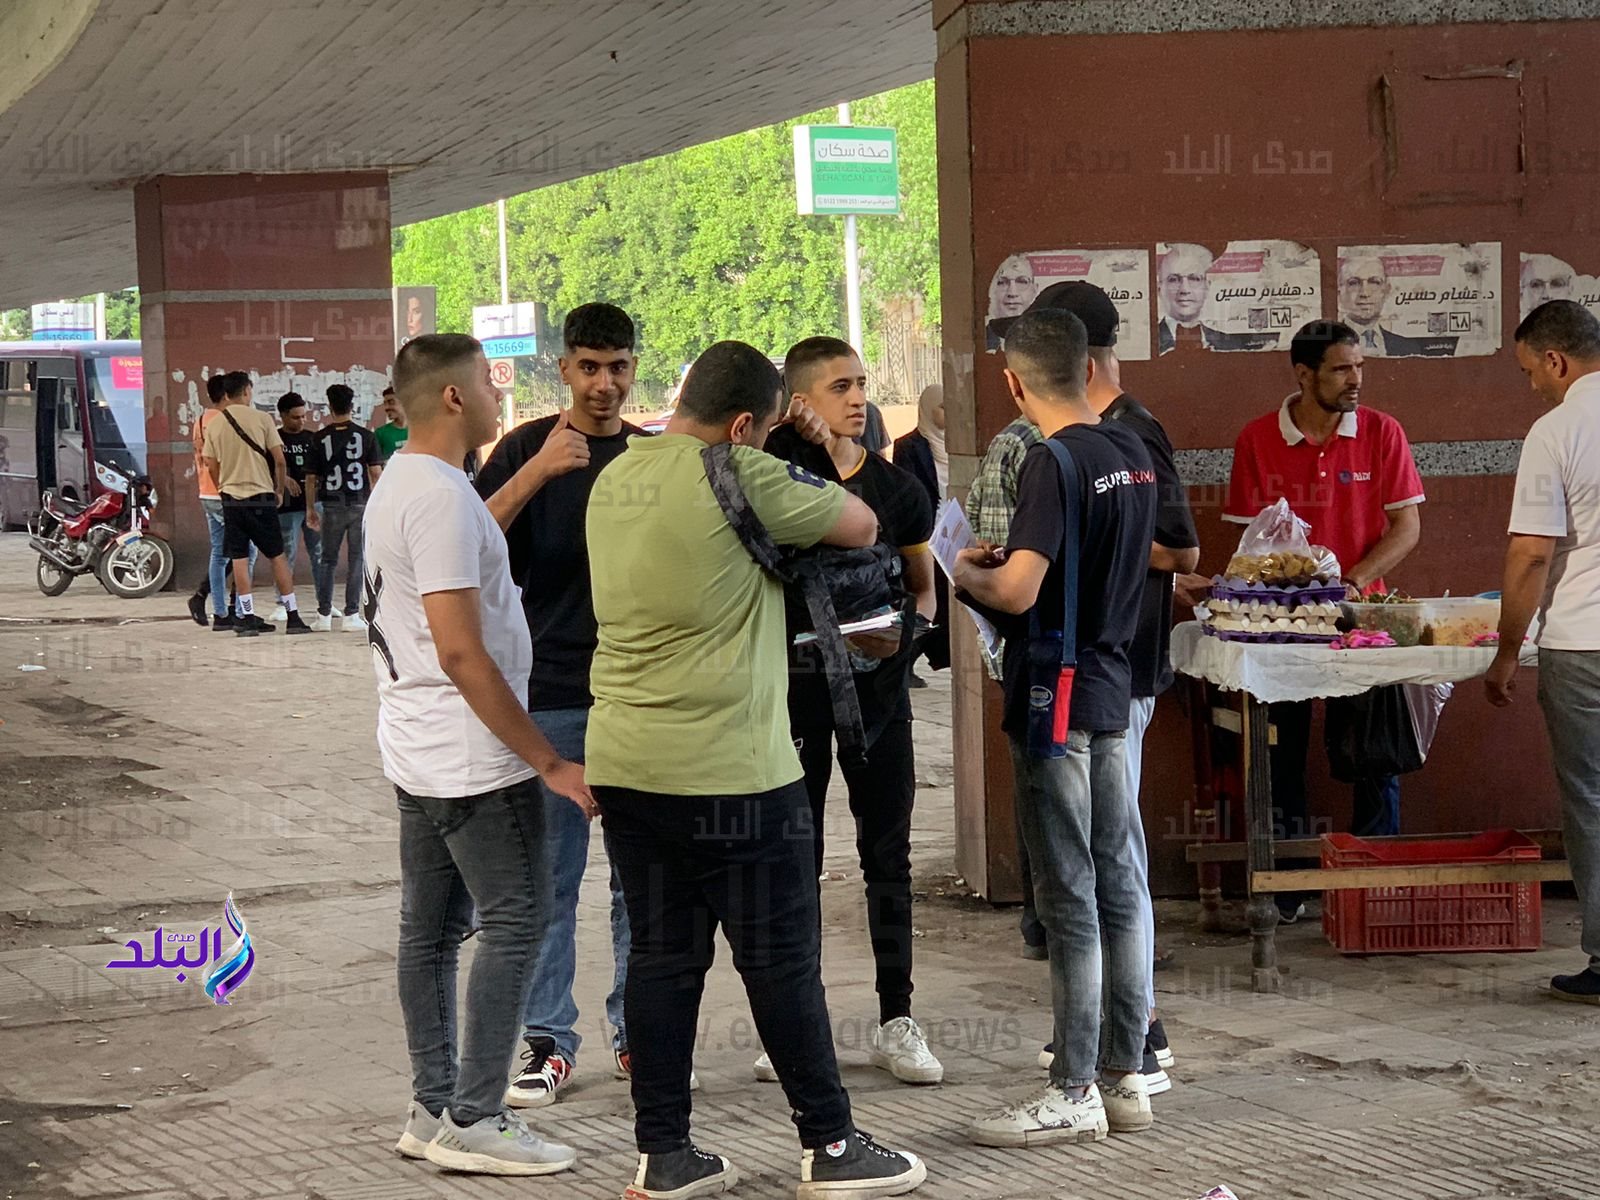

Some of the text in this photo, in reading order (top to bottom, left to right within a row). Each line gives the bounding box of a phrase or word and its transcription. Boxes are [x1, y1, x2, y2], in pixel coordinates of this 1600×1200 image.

[818, 143, 889, 158] صحة سكان
[1215, 286, 1257, 302] حسين
[1395, 289, 1437, 305] حسين
[494, 340, 525, 355] 15669
